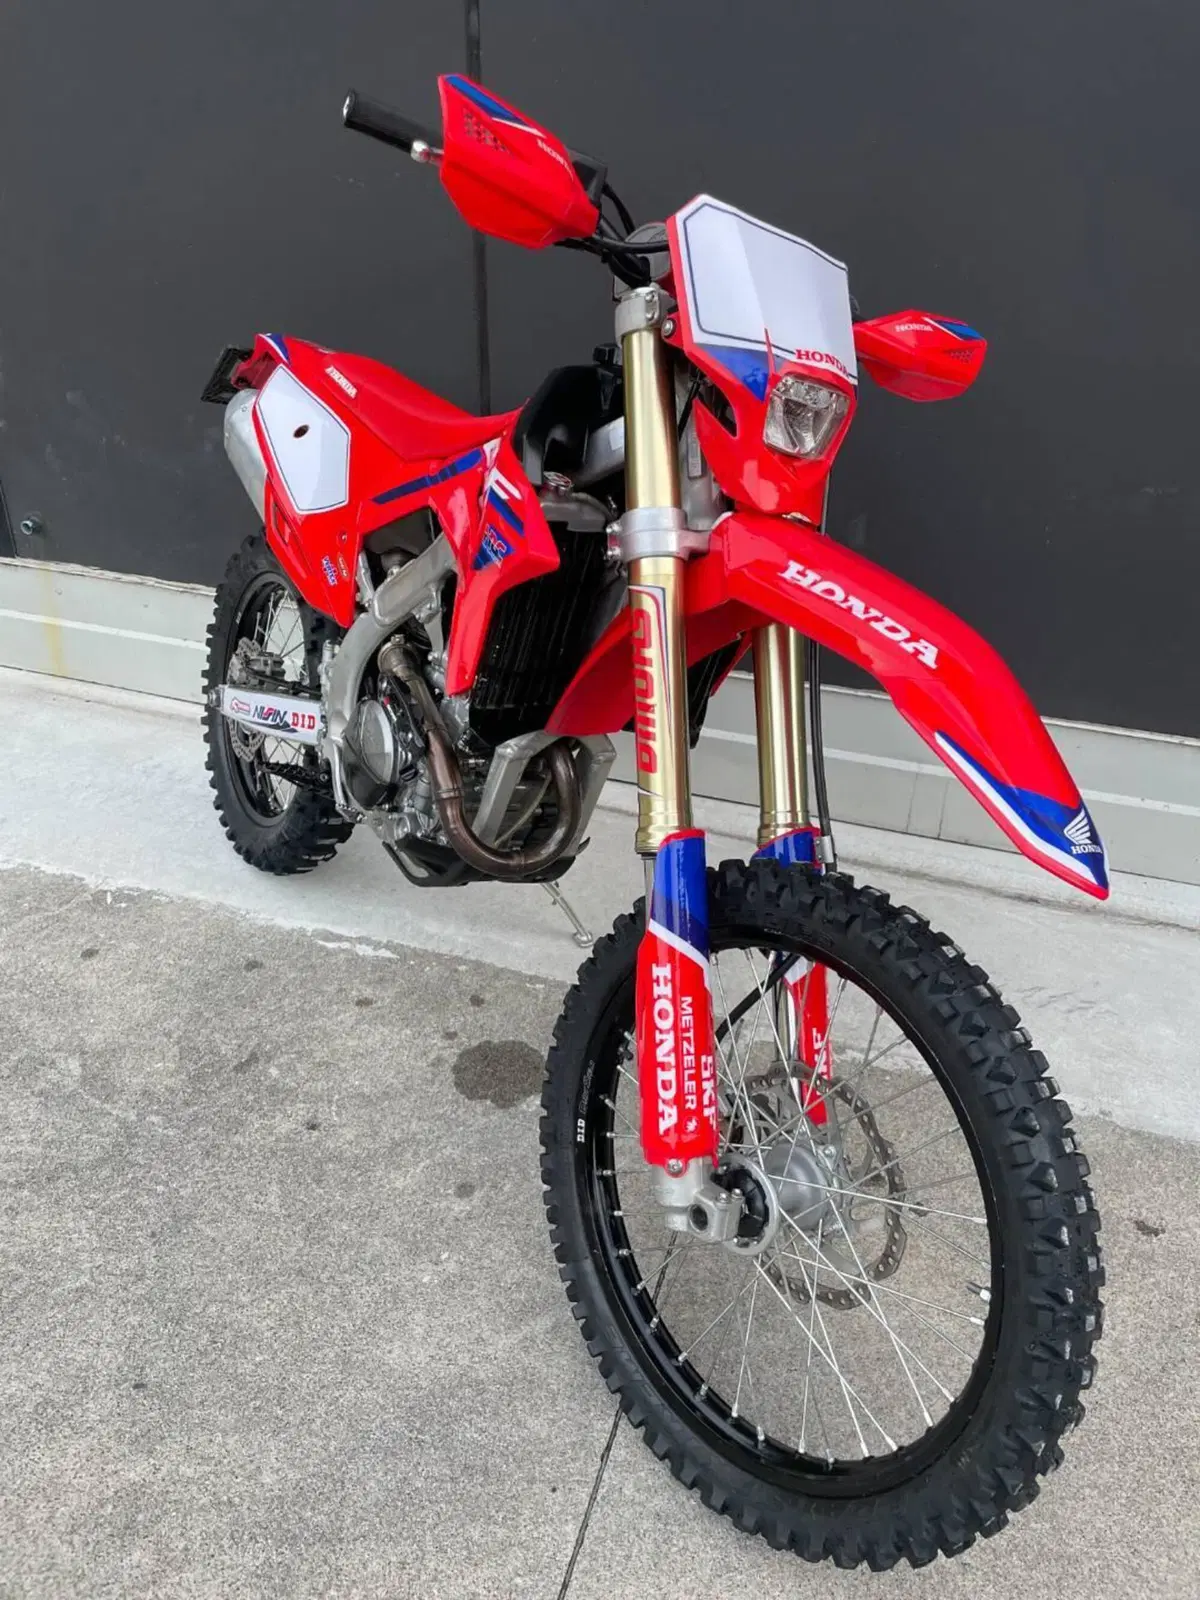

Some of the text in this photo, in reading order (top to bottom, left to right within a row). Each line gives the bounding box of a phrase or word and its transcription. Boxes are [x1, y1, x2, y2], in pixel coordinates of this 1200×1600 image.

[896, 323, 934, 333] HONDA
[796, 349, 850, 377] HONDA
[324, 366, 357, 398] HONDA
[777, 559, 938, 670] HONDA
[632, 607, 658, 775] SHOWA
[291, 711, 316, 730] DID
[1071, 845, 1103, 855] HONDA
[651, 963, 679, 1135] HONDA
[680, 996, 698, 1110] METZELER
[700, 1055, 716, 1130] SKF
[577, 1118, 585, 1143] DID
